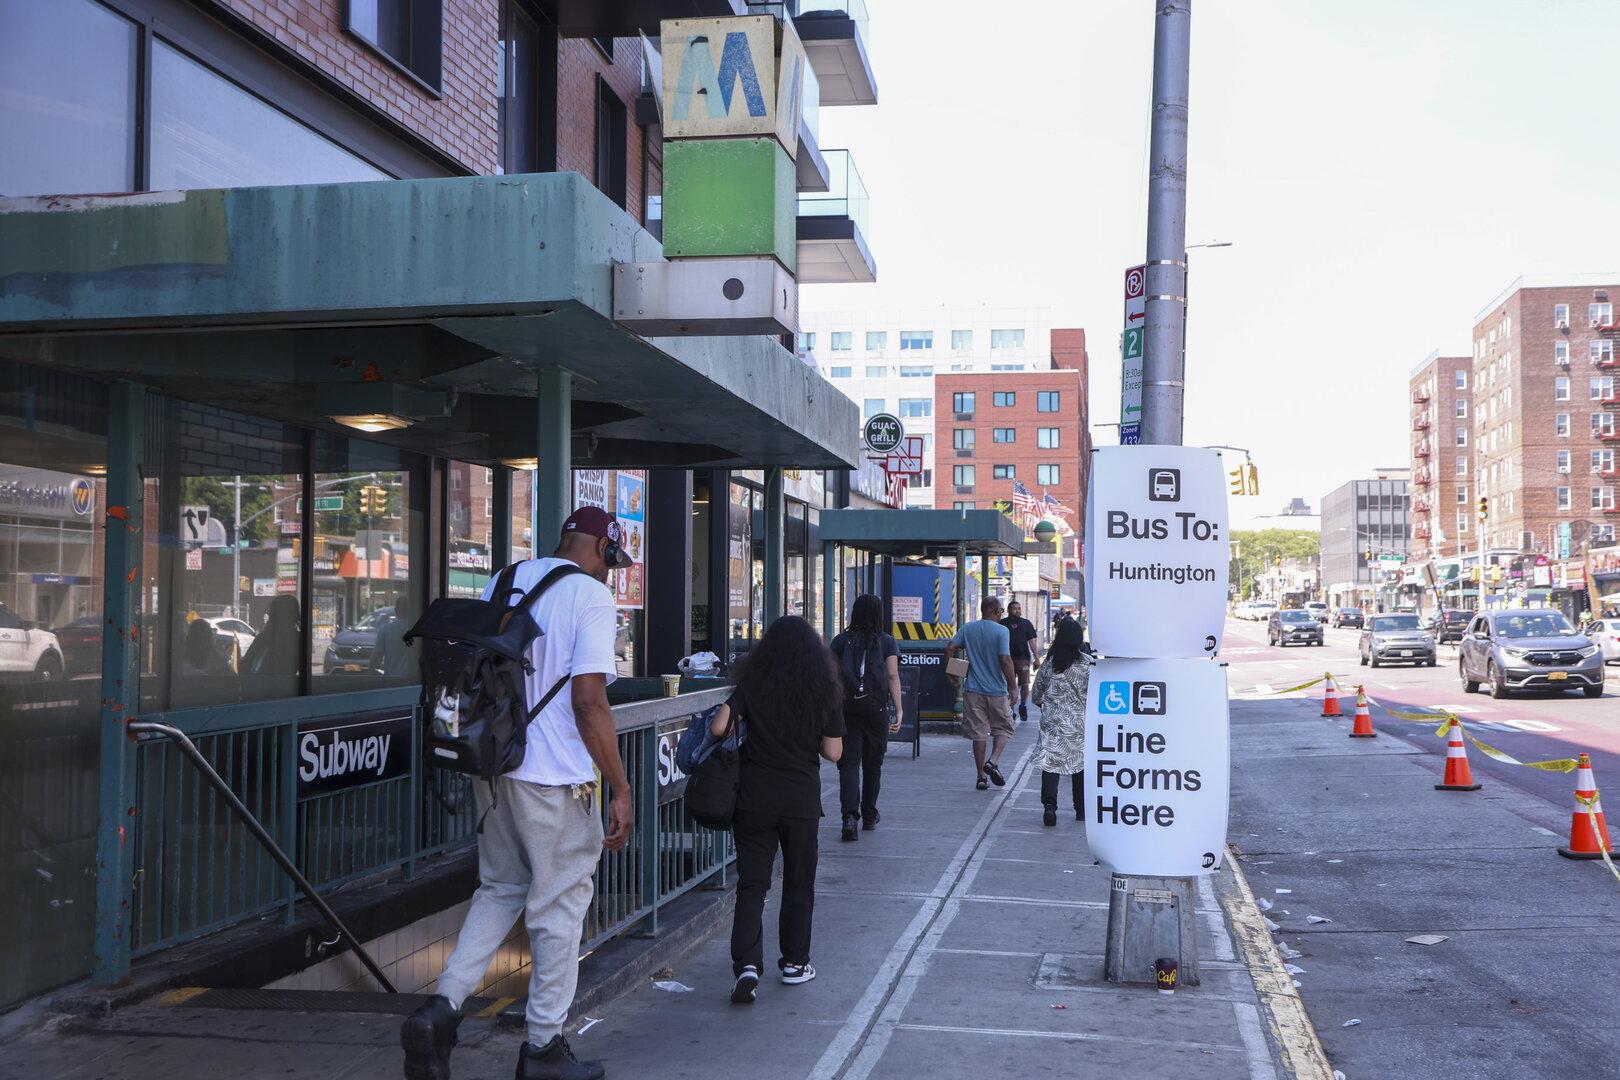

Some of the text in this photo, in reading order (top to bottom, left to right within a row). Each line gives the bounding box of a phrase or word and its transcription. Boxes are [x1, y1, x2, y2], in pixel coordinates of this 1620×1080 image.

[1128, 331, 1138, 356] 2
[1125, 381, 1142, 391] Excep
[870, 434, 896, 442] GRILL
[871, 422, 896, 430] GUAC
[579, 481, 604, 503] PANKO
[1108, 511, 1219, 541] Bus To:
[1109, 561, 1216, 585] Huntington
[900, 654, 940, 665] Station
[1098, 724, 1166, 754] Line
[299, 731, 391, 782] Subway
[1097, 759, 1202, 792] Forms
[1097, 795, 1175, 827] Here
